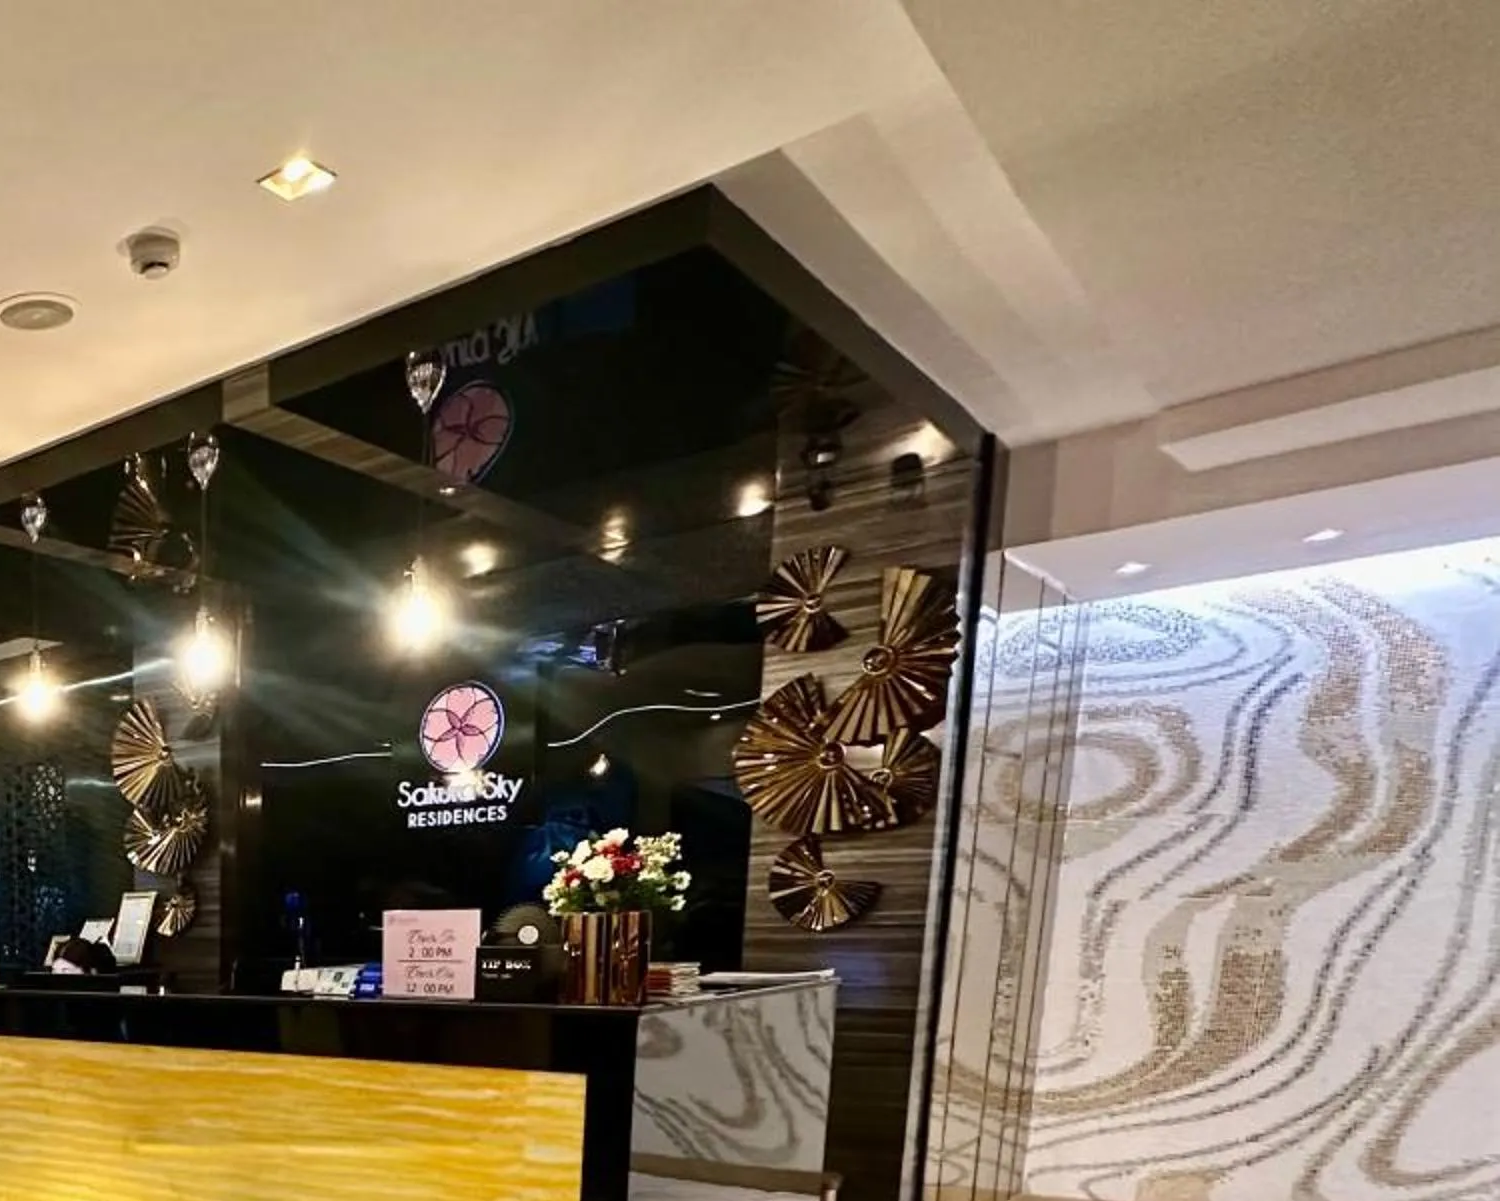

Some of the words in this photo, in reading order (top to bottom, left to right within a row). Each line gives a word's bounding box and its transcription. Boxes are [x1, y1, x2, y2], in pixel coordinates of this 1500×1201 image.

[482, 771, 524, 803] Sky
[407, 805, 508, 828] RESIDENCES
[436, 946, 453, 957] PM
[504, 959, 532, 970] BOX
[437, 983, 454, 993] PM
